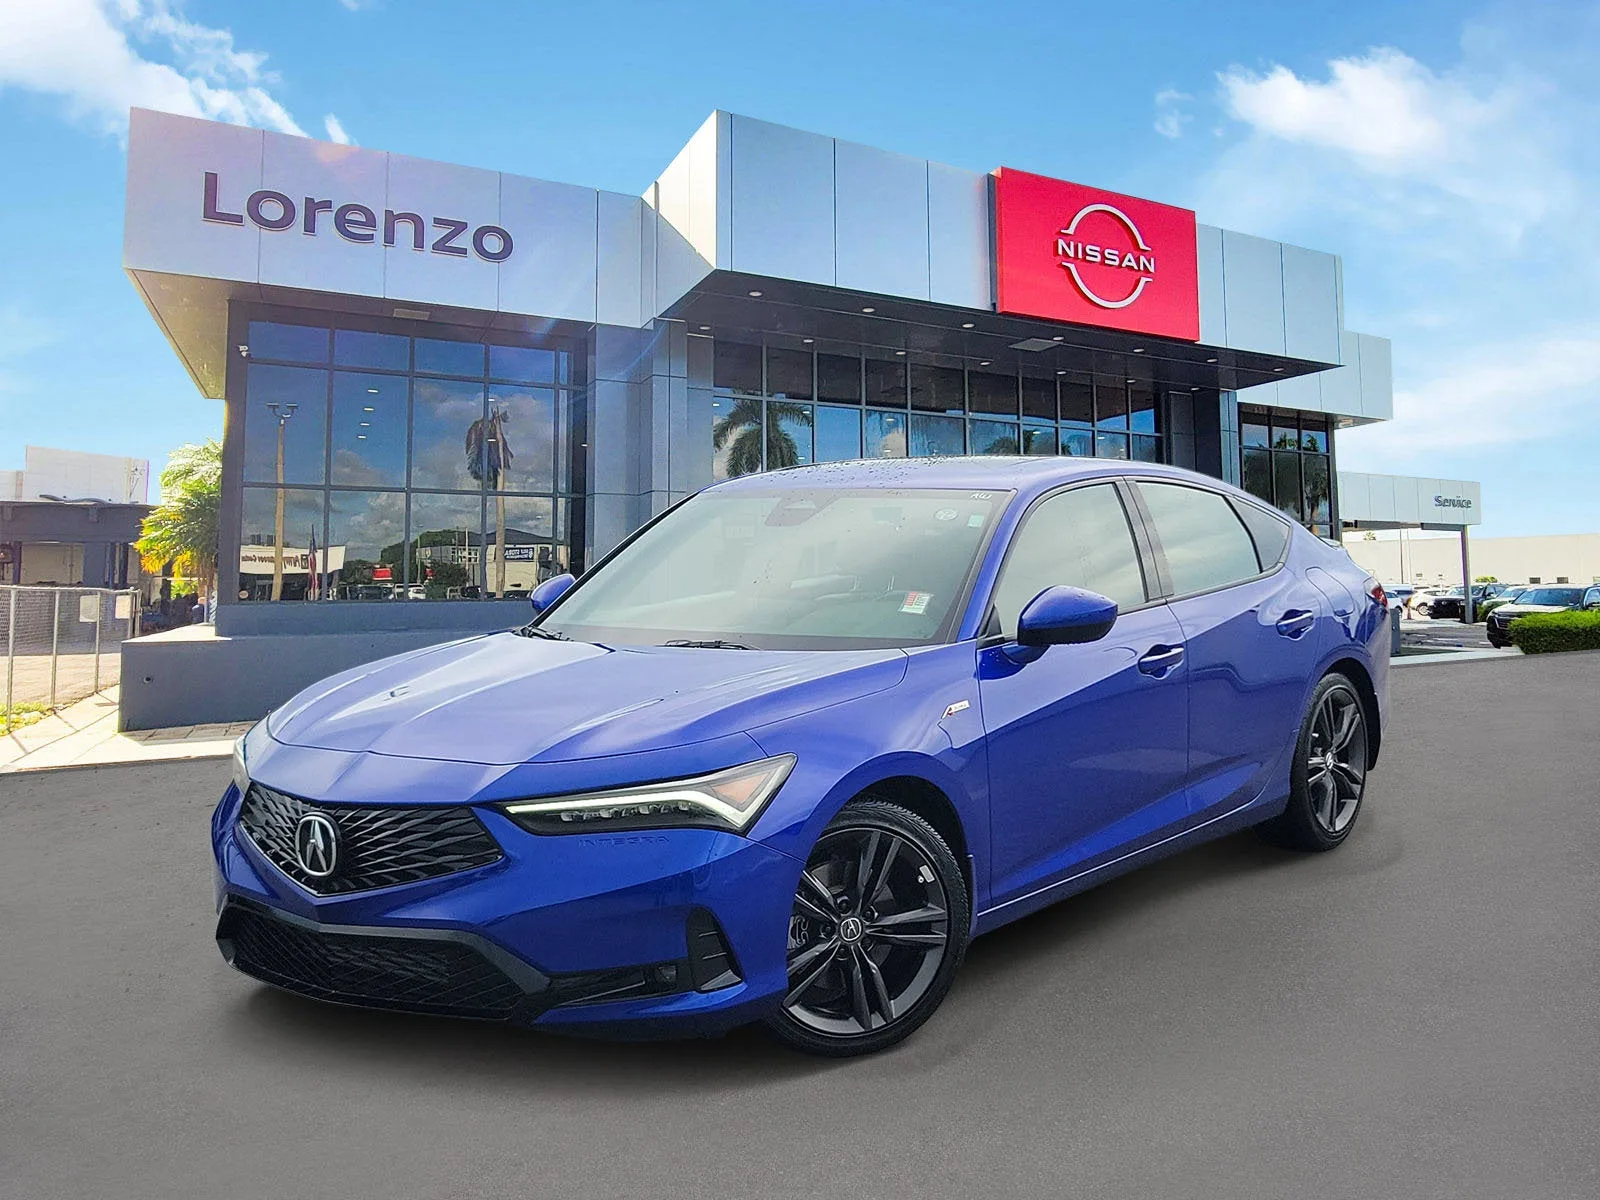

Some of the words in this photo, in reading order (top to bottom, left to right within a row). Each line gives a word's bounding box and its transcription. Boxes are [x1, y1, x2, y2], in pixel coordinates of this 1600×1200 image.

[202, 171, 514, 262] Lorenzo
[1057, 238, 1155, 273] NISSAN
[1434, 495, 1472, 509] Service
[578, 835, 670, 848] INTEGRA
